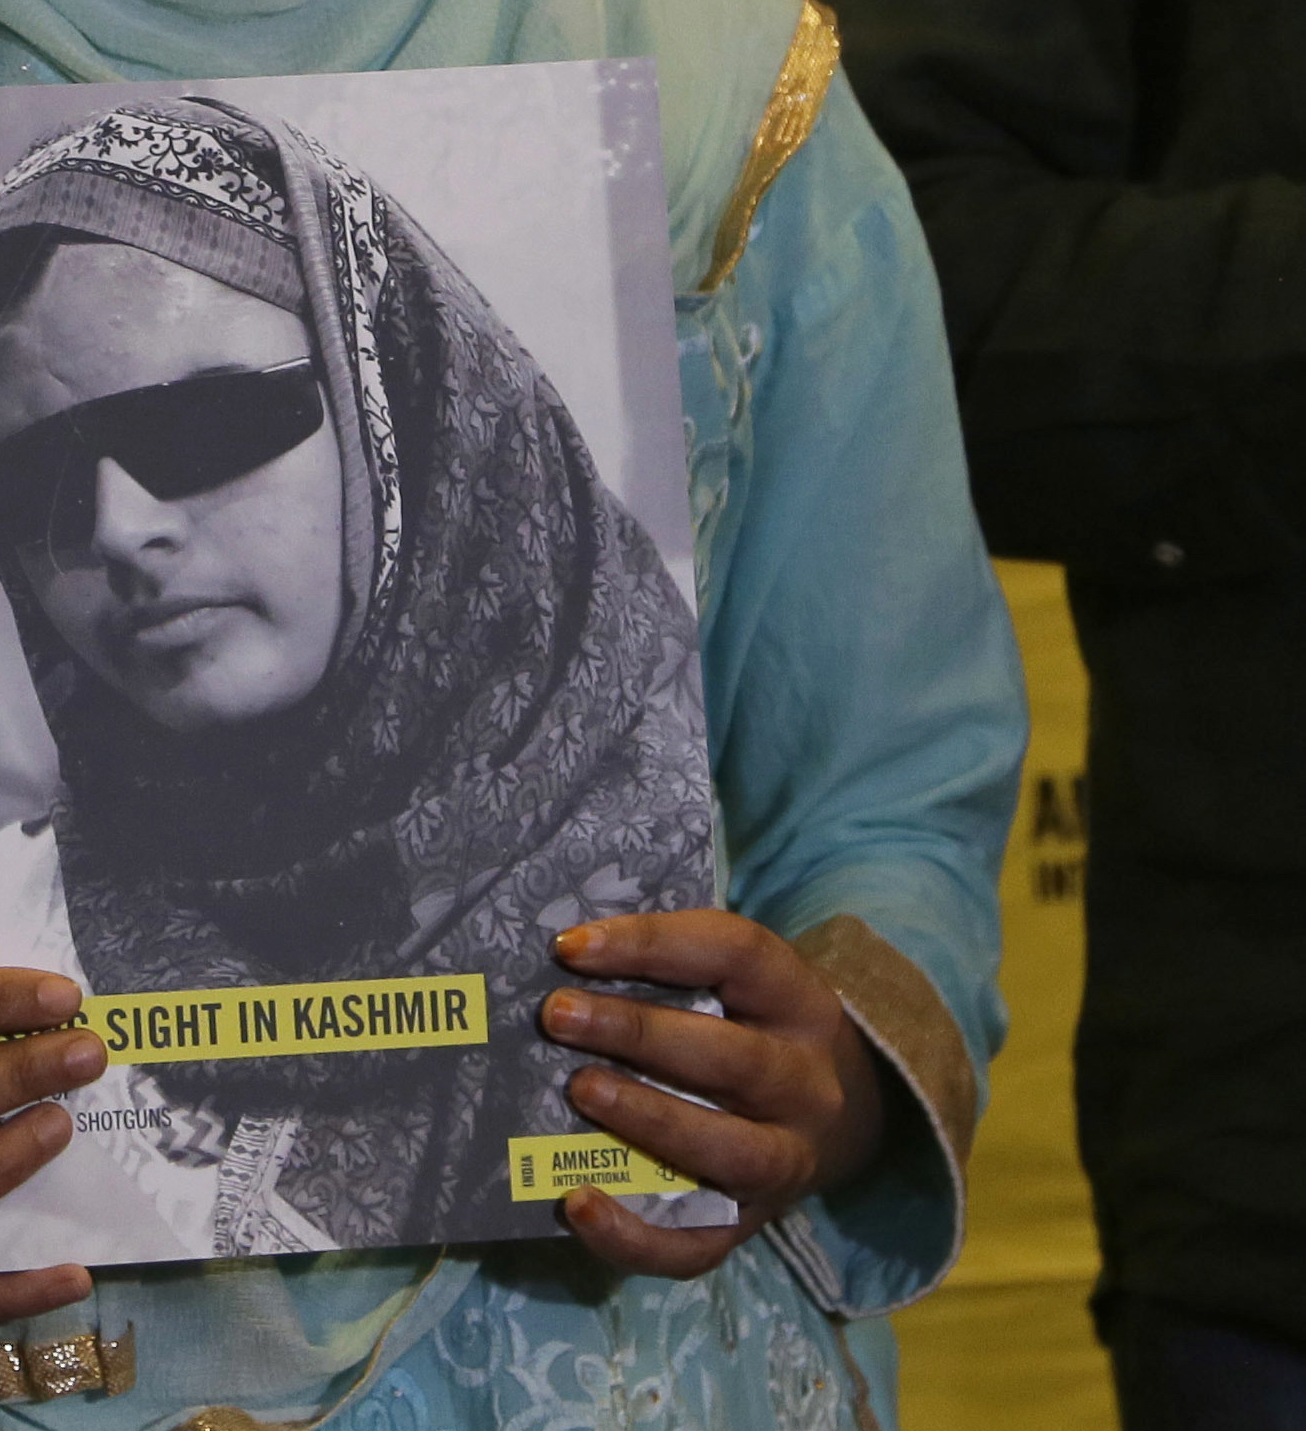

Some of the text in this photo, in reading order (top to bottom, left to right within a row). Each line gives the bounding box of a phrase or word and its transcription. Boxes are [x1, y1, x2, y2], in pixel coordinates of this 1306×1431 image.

[106, 1002, 222, 1051] SIGHT
[238, 999, 278, 1044] IN
[292, 988, 469, 1041] KASHMIR
[76, 1108, 172, 1133] SHOTGUNS
[521, 1154, 536, 1187] INDIA
[552, 1147, 632, 1171] AMNESTY
[552, 1171, 632, 1187] INTERNATIONAL
